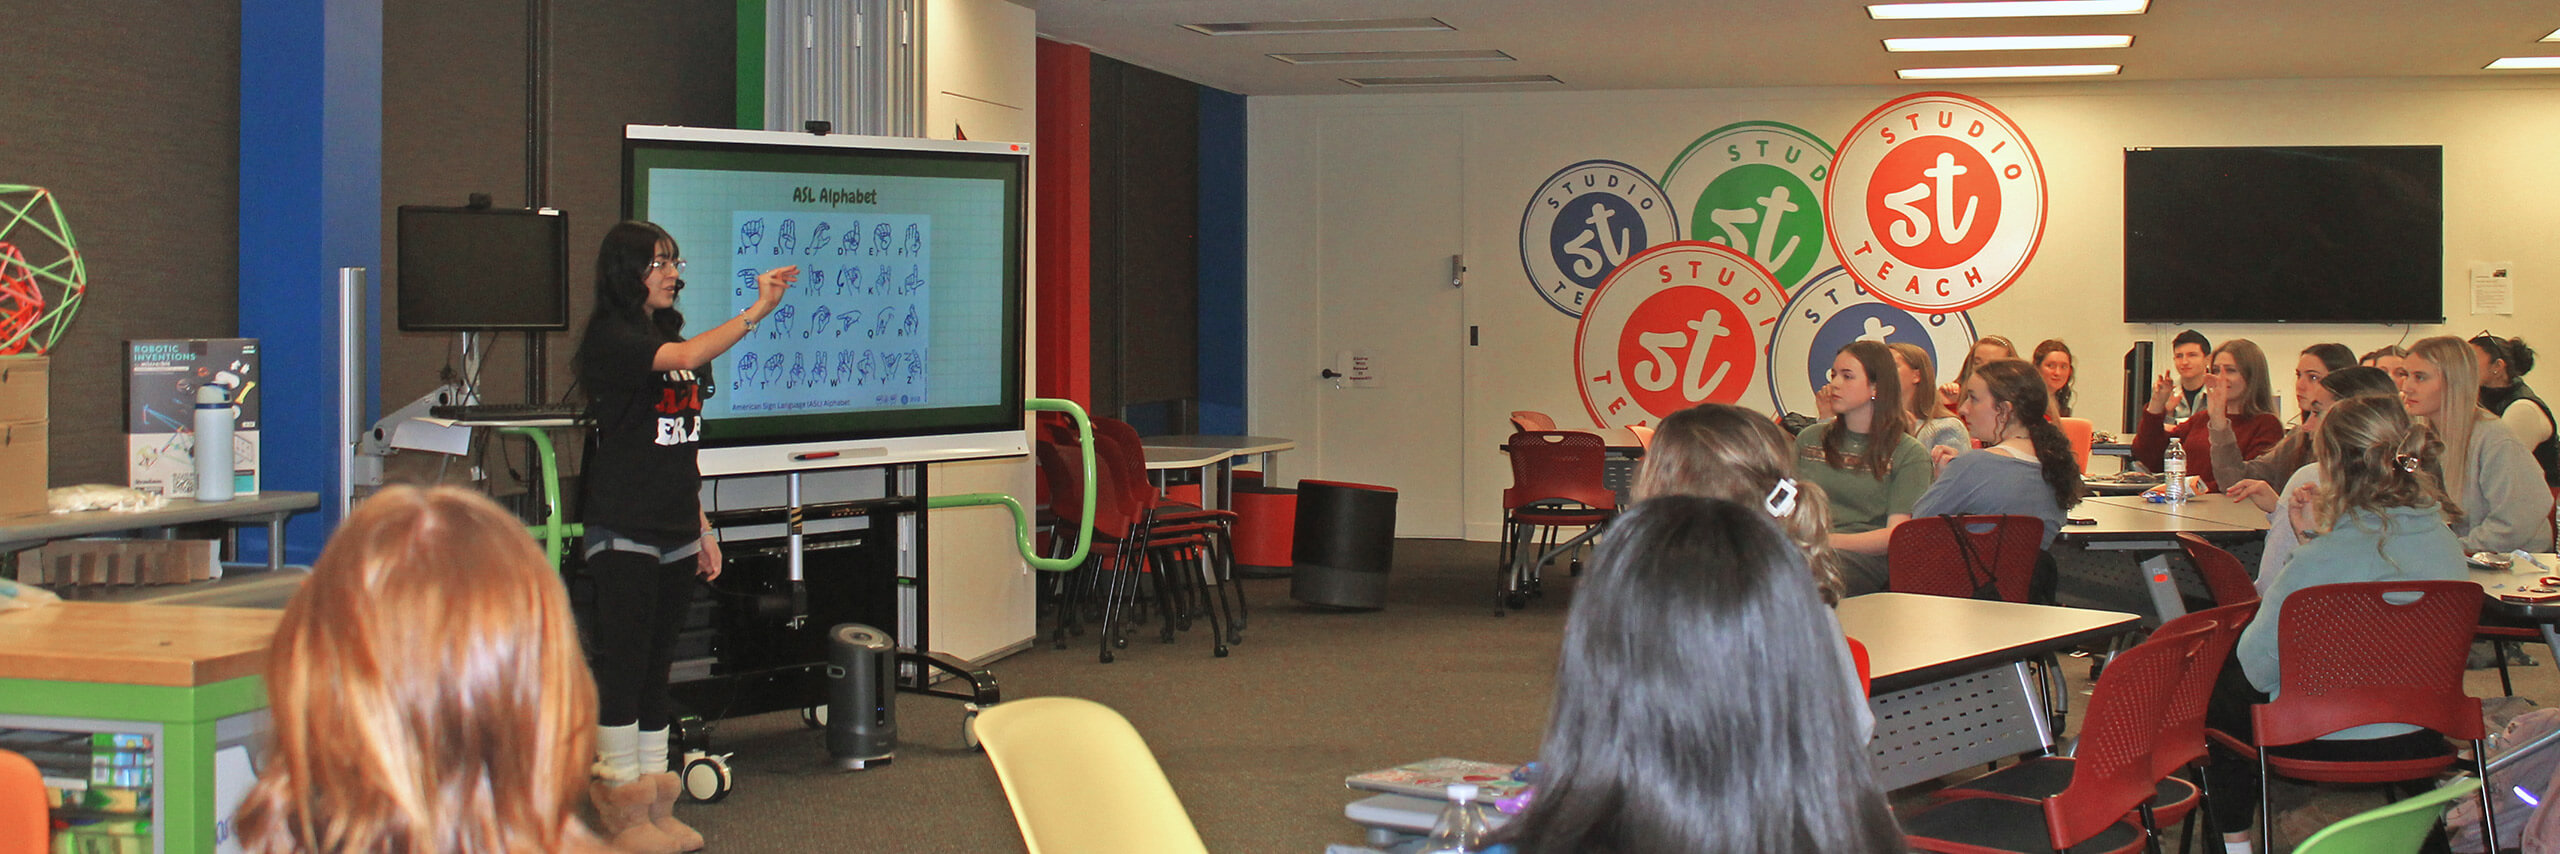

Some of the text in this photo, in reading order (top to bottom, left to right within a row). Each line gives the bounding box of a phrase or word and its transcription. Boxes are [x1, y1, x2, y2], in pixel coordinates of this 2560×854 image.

[1880, 110, 2022, 180] STUDIO
[1727, 140, 1827, 182] STUD
[793, 187, 877, 208] ASL Alphabet
[1548, 174, 1653, 210] STUDIO
[1884, 152, 1979, 247] st
[737, 247, 743, 255] A
[805, 248, 810, 256] C
[838, 248, 843, 256] D
[869, 248, 874, 256] E
[898, 248, 903, 256] F
[1563, 202, 1630, 278] st
[1854, 240, 1982, 297] TEACH
[736, 288, 742, 296] G
[868, 287, 873, 295] K
[898, 287, 903, 295] L
[1658, 261, 1776, 356] STUDI
[770, 329, 903, 339] N O P Q R
[134, 345, 179, 353] ROBOTIC
[134, 352, 197, 361] INVENTIONS
[1633, 309, 1731, 402] st
[733, 376, 912, 390] S T U V W X Y Z
[762, 402, 776, 411] Sign
[777, 401, 805, 410] Language
[823, 399, 851, 408] Alphabet
